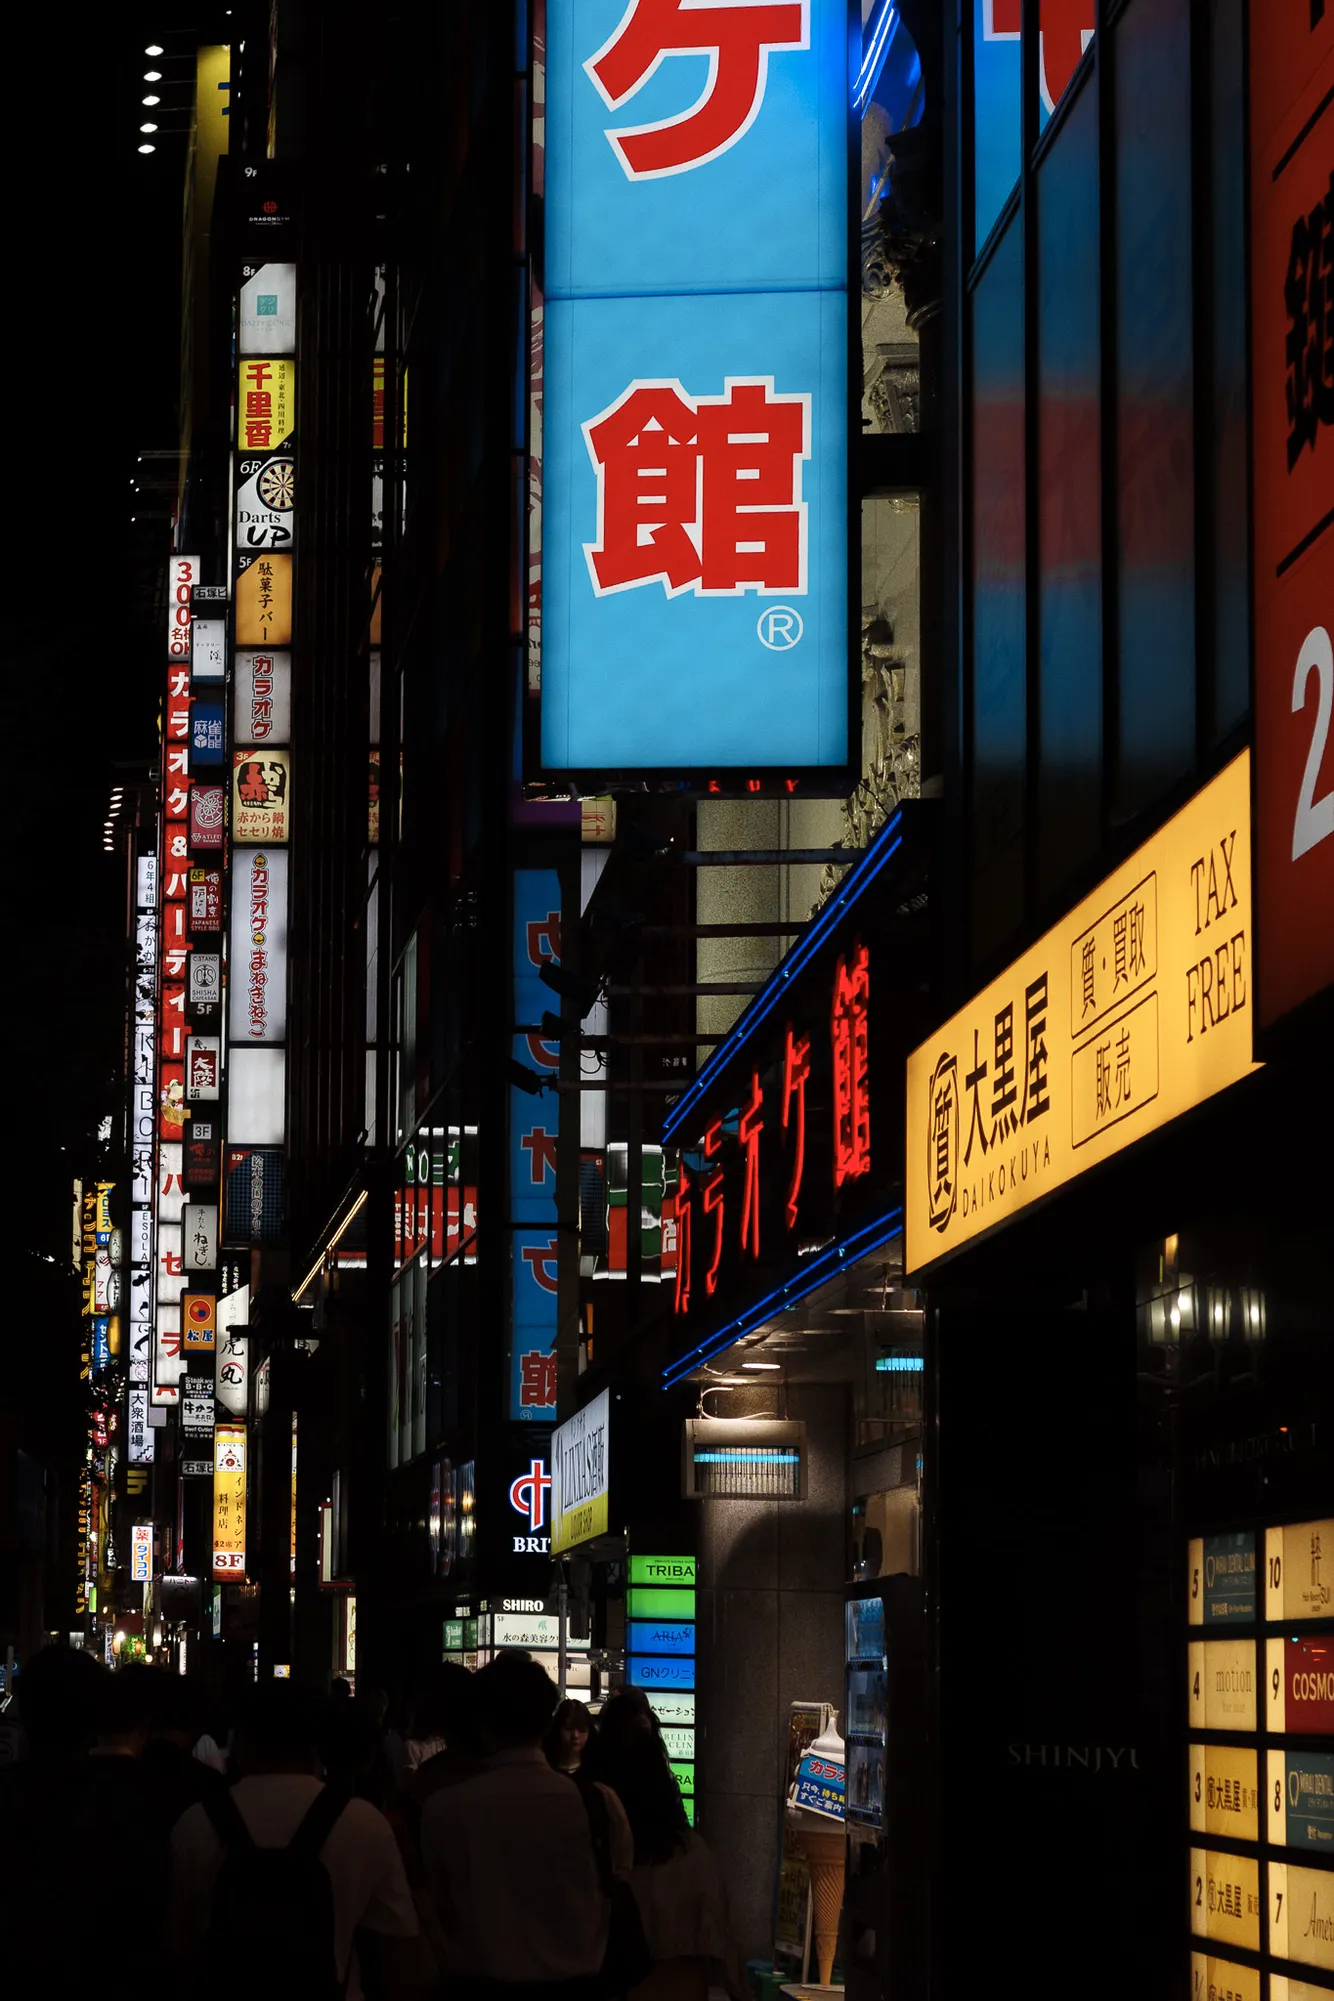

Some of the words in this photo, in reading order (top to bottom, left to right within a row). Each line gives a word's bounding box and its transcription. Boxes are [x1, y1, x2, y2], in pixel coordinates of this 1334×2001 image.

[244, 167, 257, 177] 9F
[243, 266, 256, 277] 8F
[245, 362, 273, 448] 千里香
[239, 460, 263, 475] 6F
[239, 511, 281, 524] Darts
[246, 525, 292, 548] UP
[239, 556, 252, 569] 5F
[257, 562, 274, 641] 駄菓子バー
[252, 655, 274, 740] カラオケ
[194, 720, 222, 735] 麻雀
[236, 752, 250, 761] 3F
[236, 826, 285, 839] セセリ焼
[237, 811, 285, 825] 赤から鍋
[191, 870, 204, 881] 6F
[1189, 829, 1238, 936] TAX
[251, 867, 270, 932] カラオケ
[248, 948, 269, 1040] まねきねこ
[1184, 930, 1245, 1044] FREE
[197, 1003, 213, 1015] 5F
[963, 970, 1051, 1169] 大黒屋
[1094, 1027, 1131, 1121] 販売
[195, 1126, 210, 1137] 3F
[962, 1134, 1052, 1219] DAIKOKUYA
[142, 1212, 151, 1262] ESOLA
[186, 1329, 214, 1342] 松屋
[131, 1393, 145, 1448] 大衆酒場
[218, 1493, 229, 1529] 料理店
[233, 1477, 244, 1549] インドネシア
[214, 1554, 243, 1568] 8F
[1269, 1556, 1282, 1590] 10
[1191, 1568, 1199, 1599] 5
[503, 1599, 544, 1612] SHIRO
[1192, 1672, 1200, 1701] 4
[1216, 1661, 1252, 1692] motion
[1272, 1669, 1280, 1701] 9
[1195, 1772, 1201, 1804] 3
[1274, 1779, 1281, 1812] 8
[1196, 1877, 1202, 1907] 2
[1275, 1893, 1282, 1925] 7
